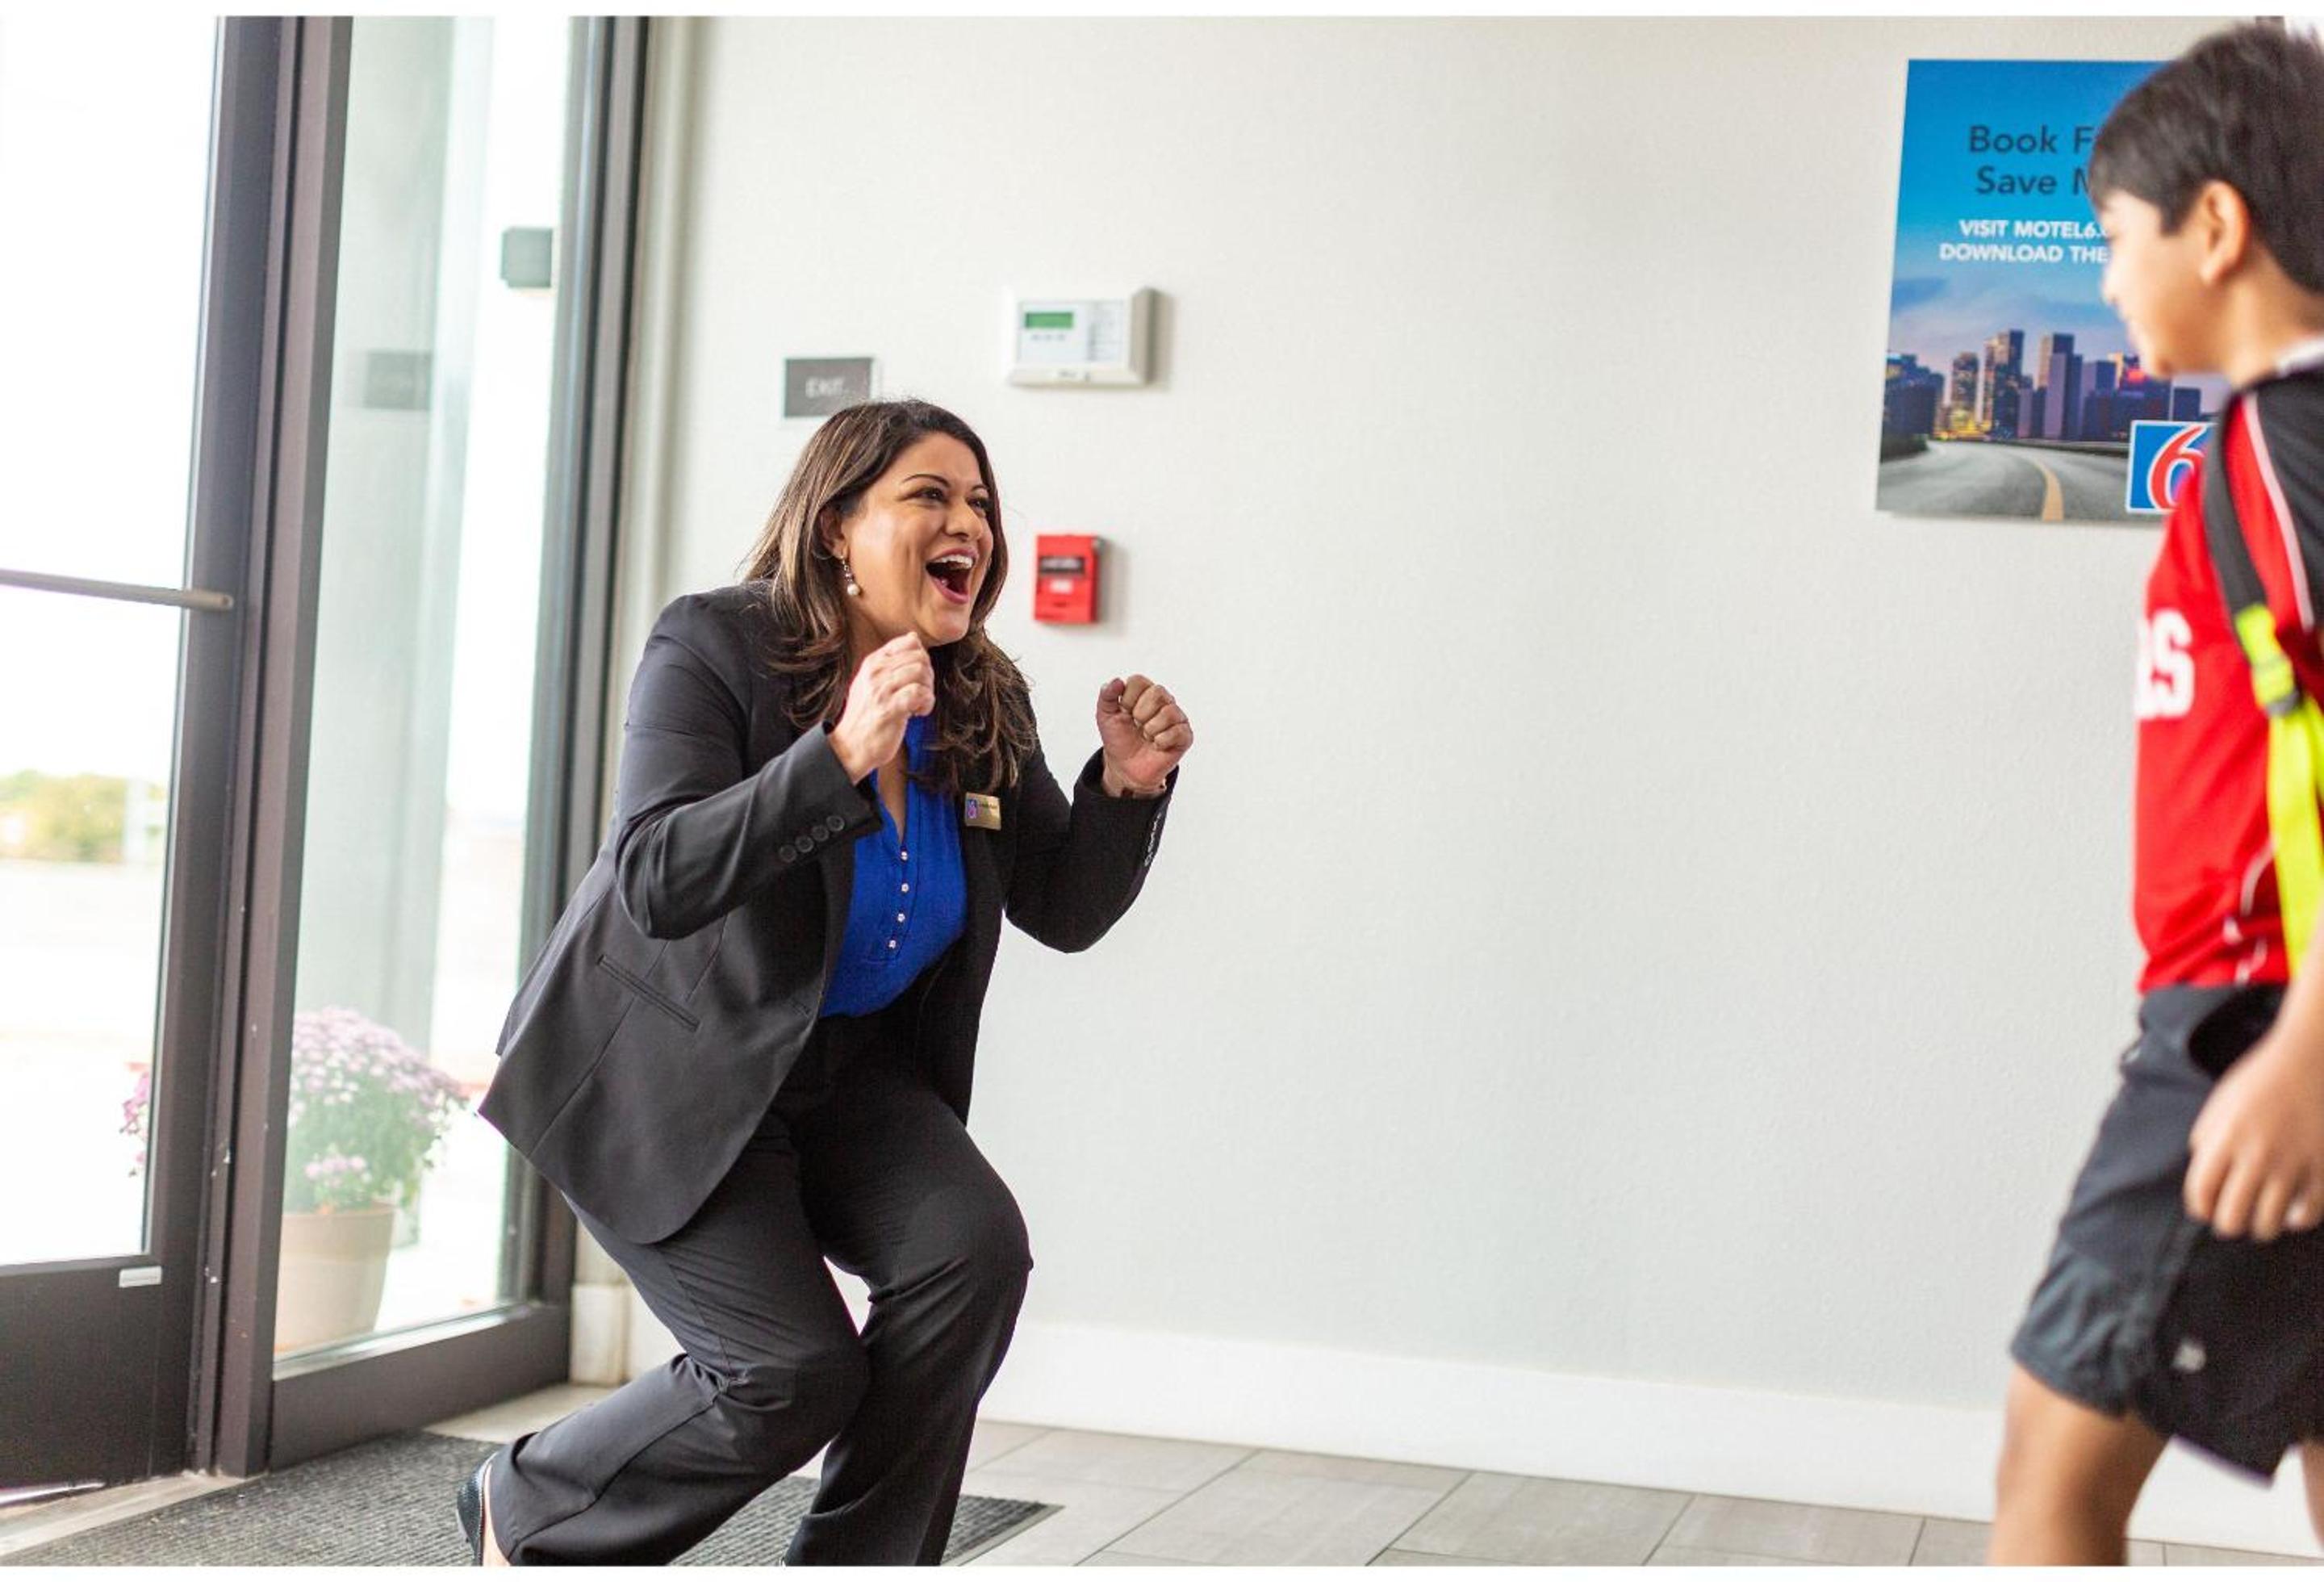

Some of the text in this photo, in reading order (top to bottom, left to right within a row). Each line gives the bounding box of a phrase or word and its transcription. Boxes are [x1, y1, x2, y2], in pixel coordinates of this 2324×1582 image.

[1969, 125, 2057, 153] Book
[1976, 165, 2056, 195] Save
[1958, 220, 2108, 238] VISIT MOTEL6.
[1940, 244, 2109, 264] DOWNLOAD THE
[2147, 424, 2206, 514] 6
